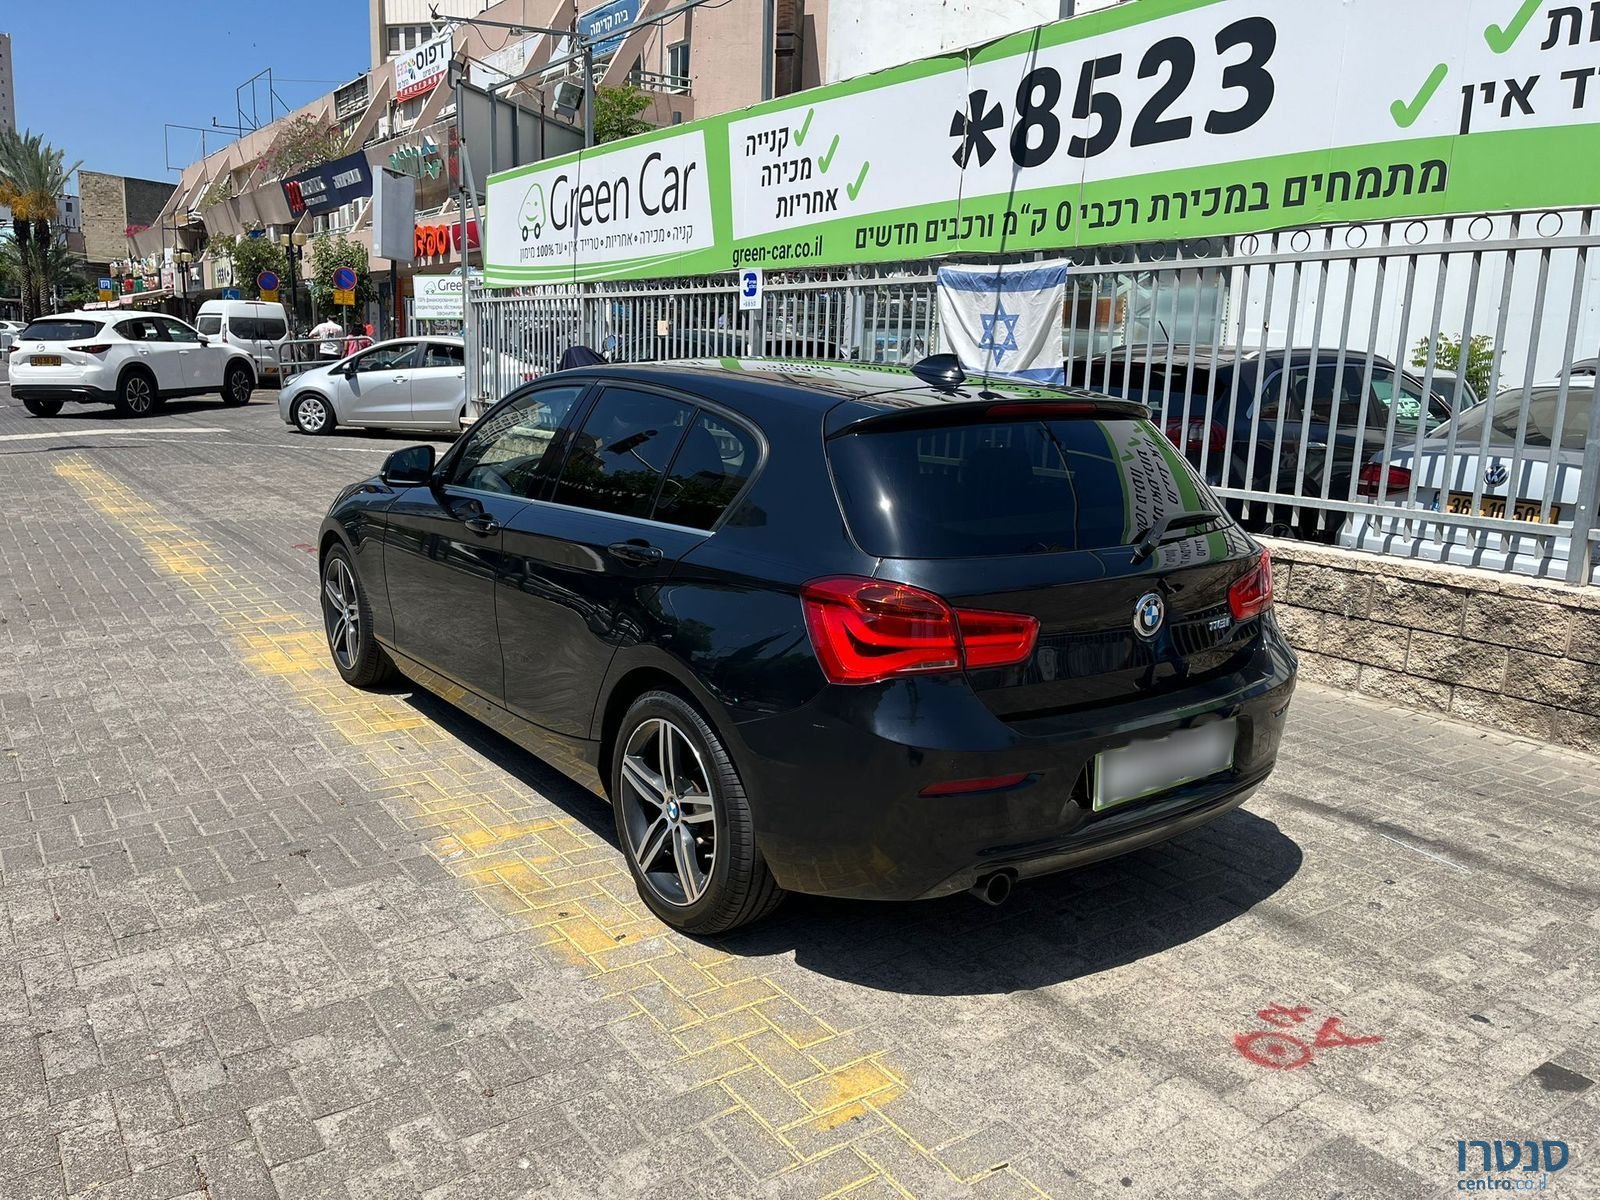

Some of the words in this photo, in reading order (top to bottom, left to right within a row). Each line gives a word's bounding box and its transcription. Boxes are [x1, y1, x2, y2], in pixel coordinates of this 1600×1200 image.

[590, 15, 613, 37] קדימה
[614, 9, 629, 25] בית
[1459, 75, 1541, 135] אין
[746, 127, 790, 157] קנייה
[761, 157, 812, 187] מכירה
[1282, 159, 1448, 208] מתמחים
[550, 174, 630, 231] Green
[638, 151, 696, 216] Car
[776, 188, 839, 219] אחריות
[1147, 181, 1270, 223] במכירת
[925, 213, 994, 243] ורכבים
[1056, 200, 1072, 232] 0
[1080, 198, 1139, 229] רכבי
[580, 237, 599, 251] טרייד
[605, 232, 633, 249] אחריות
[640, 229, 665, 245] מכירה
[672, 224, 693, 245] קניה
[855, 222, 919, 249] חדשים
[519, 246, 535, 263] מימון
[536, 245, 554, 258] 100%
[732, 235, 823, 267] green-car.co.il
[438, 279, 462, 291] Gree
